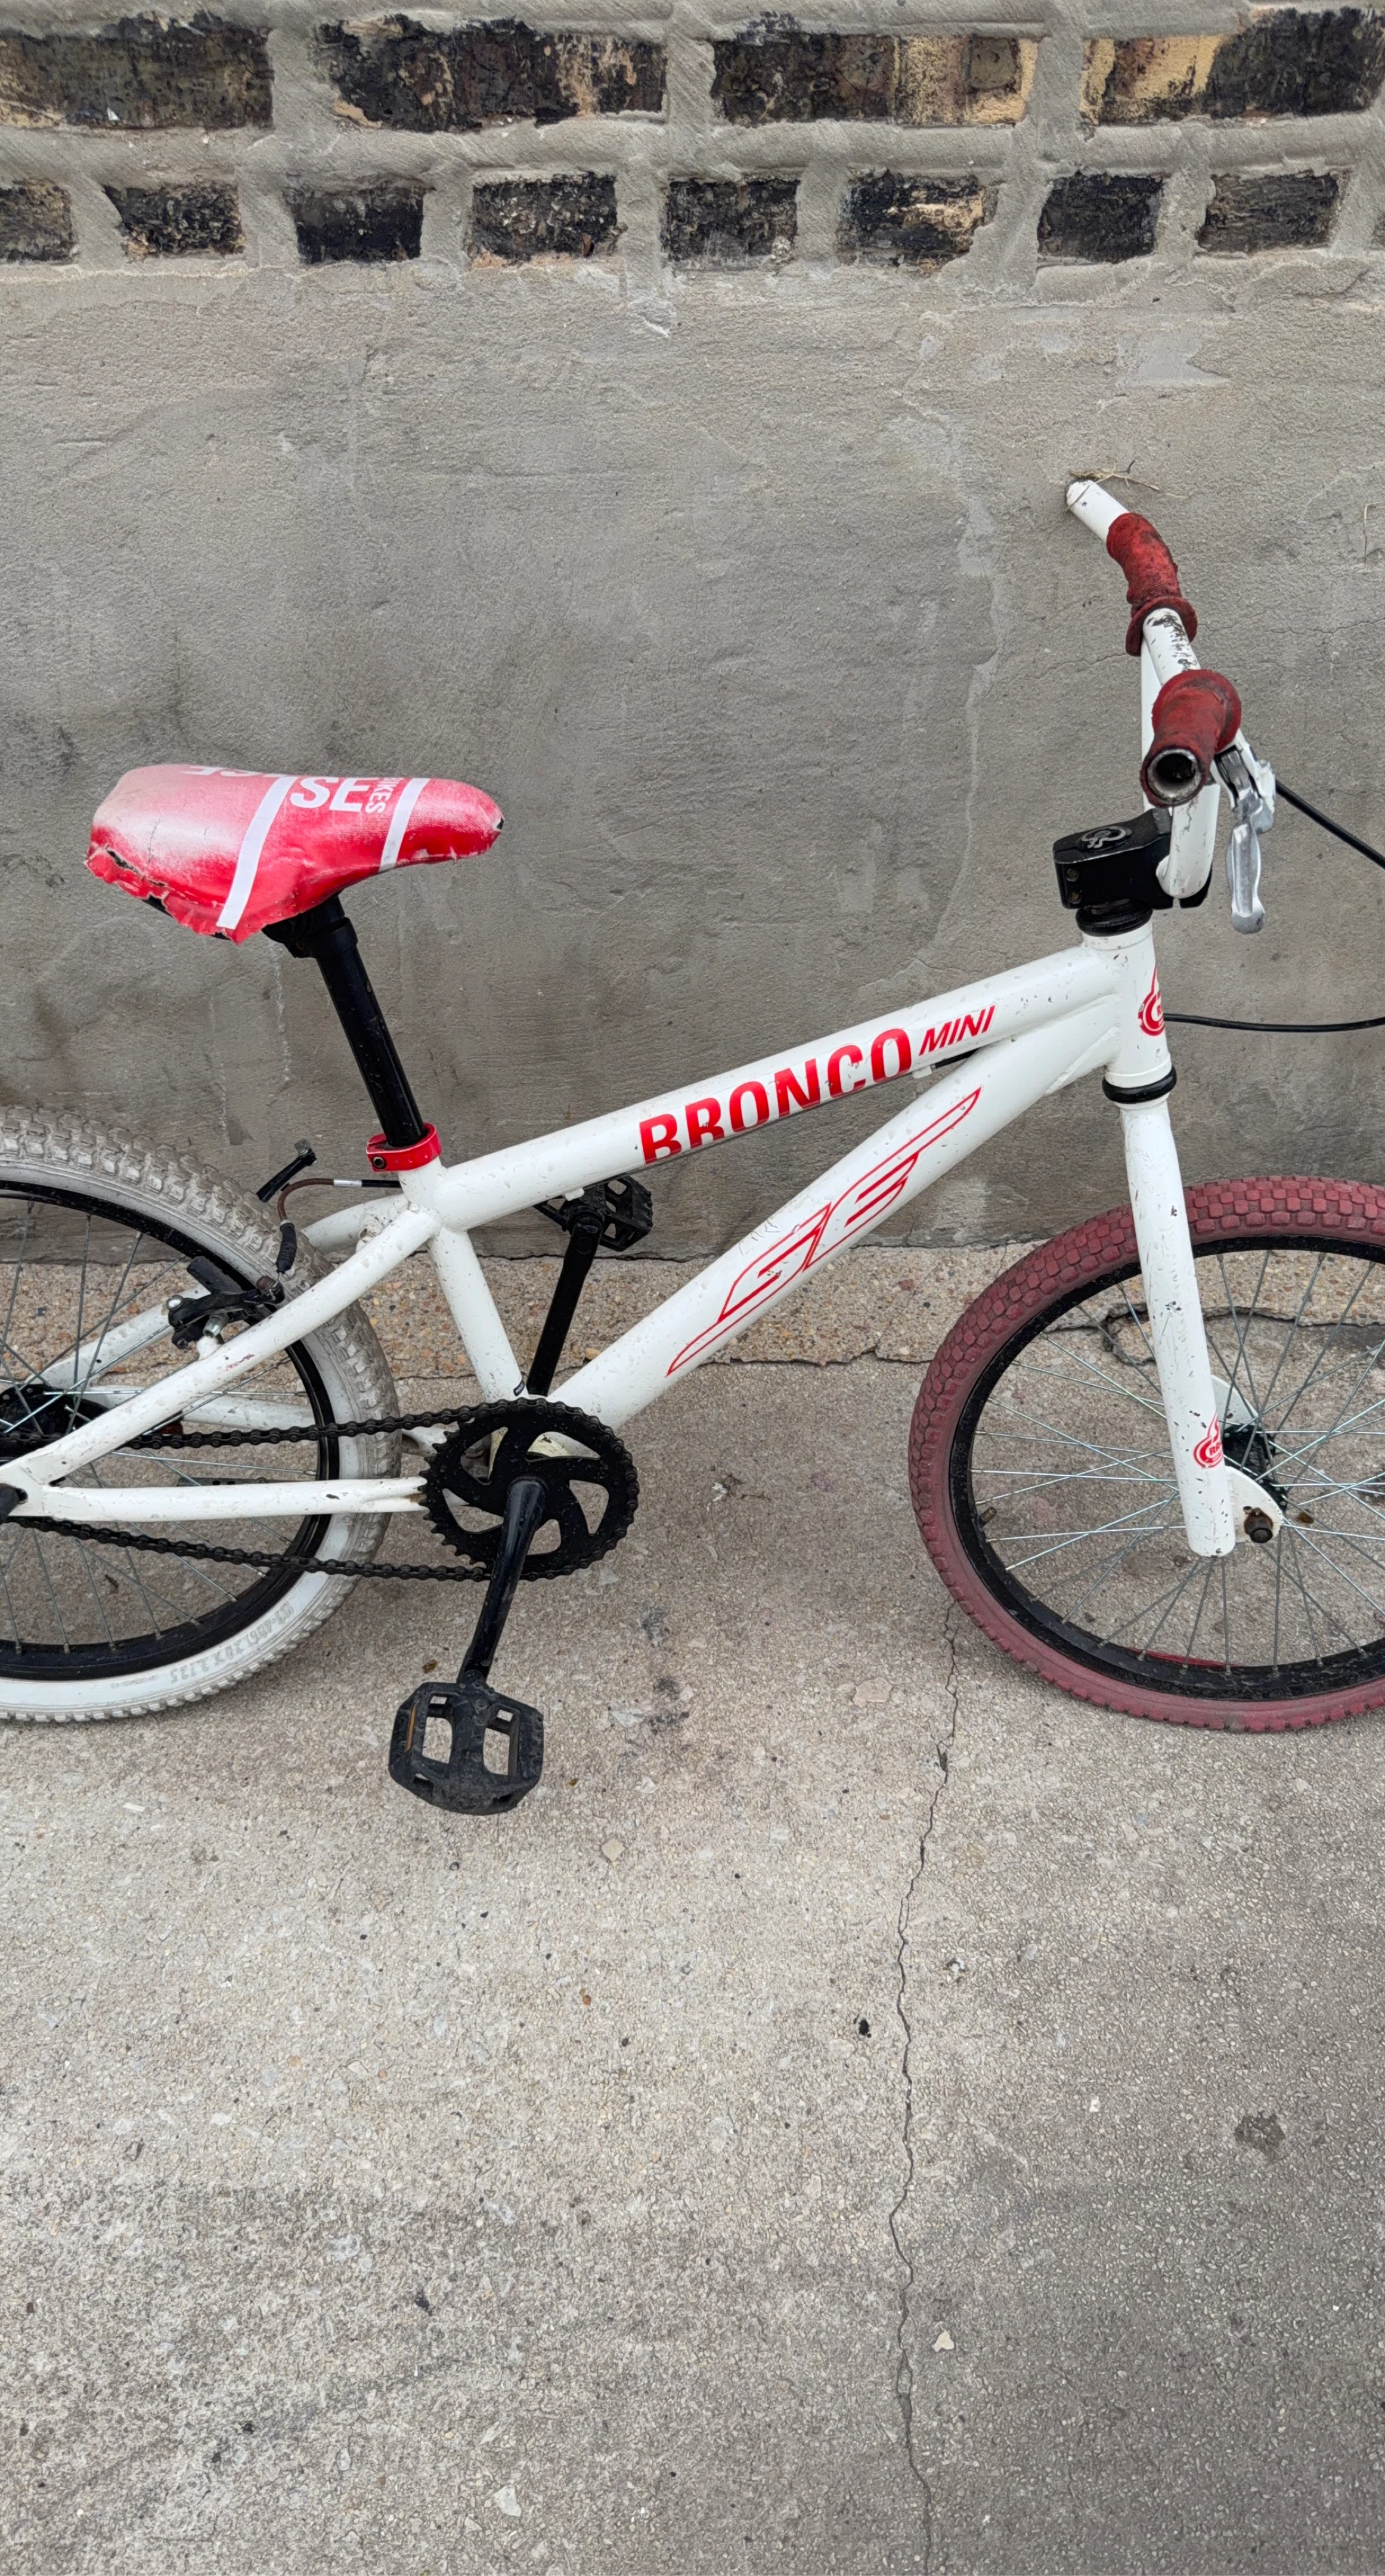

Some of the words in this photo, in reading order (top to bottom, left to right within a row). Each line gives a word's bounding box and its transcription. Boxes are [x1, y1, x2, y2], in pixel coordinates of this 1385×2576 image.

[290, 776, 380, 812] SE
[639, 1028, 912, 1165] BRONCO
[919, 1004, 996, 1057] MINI
